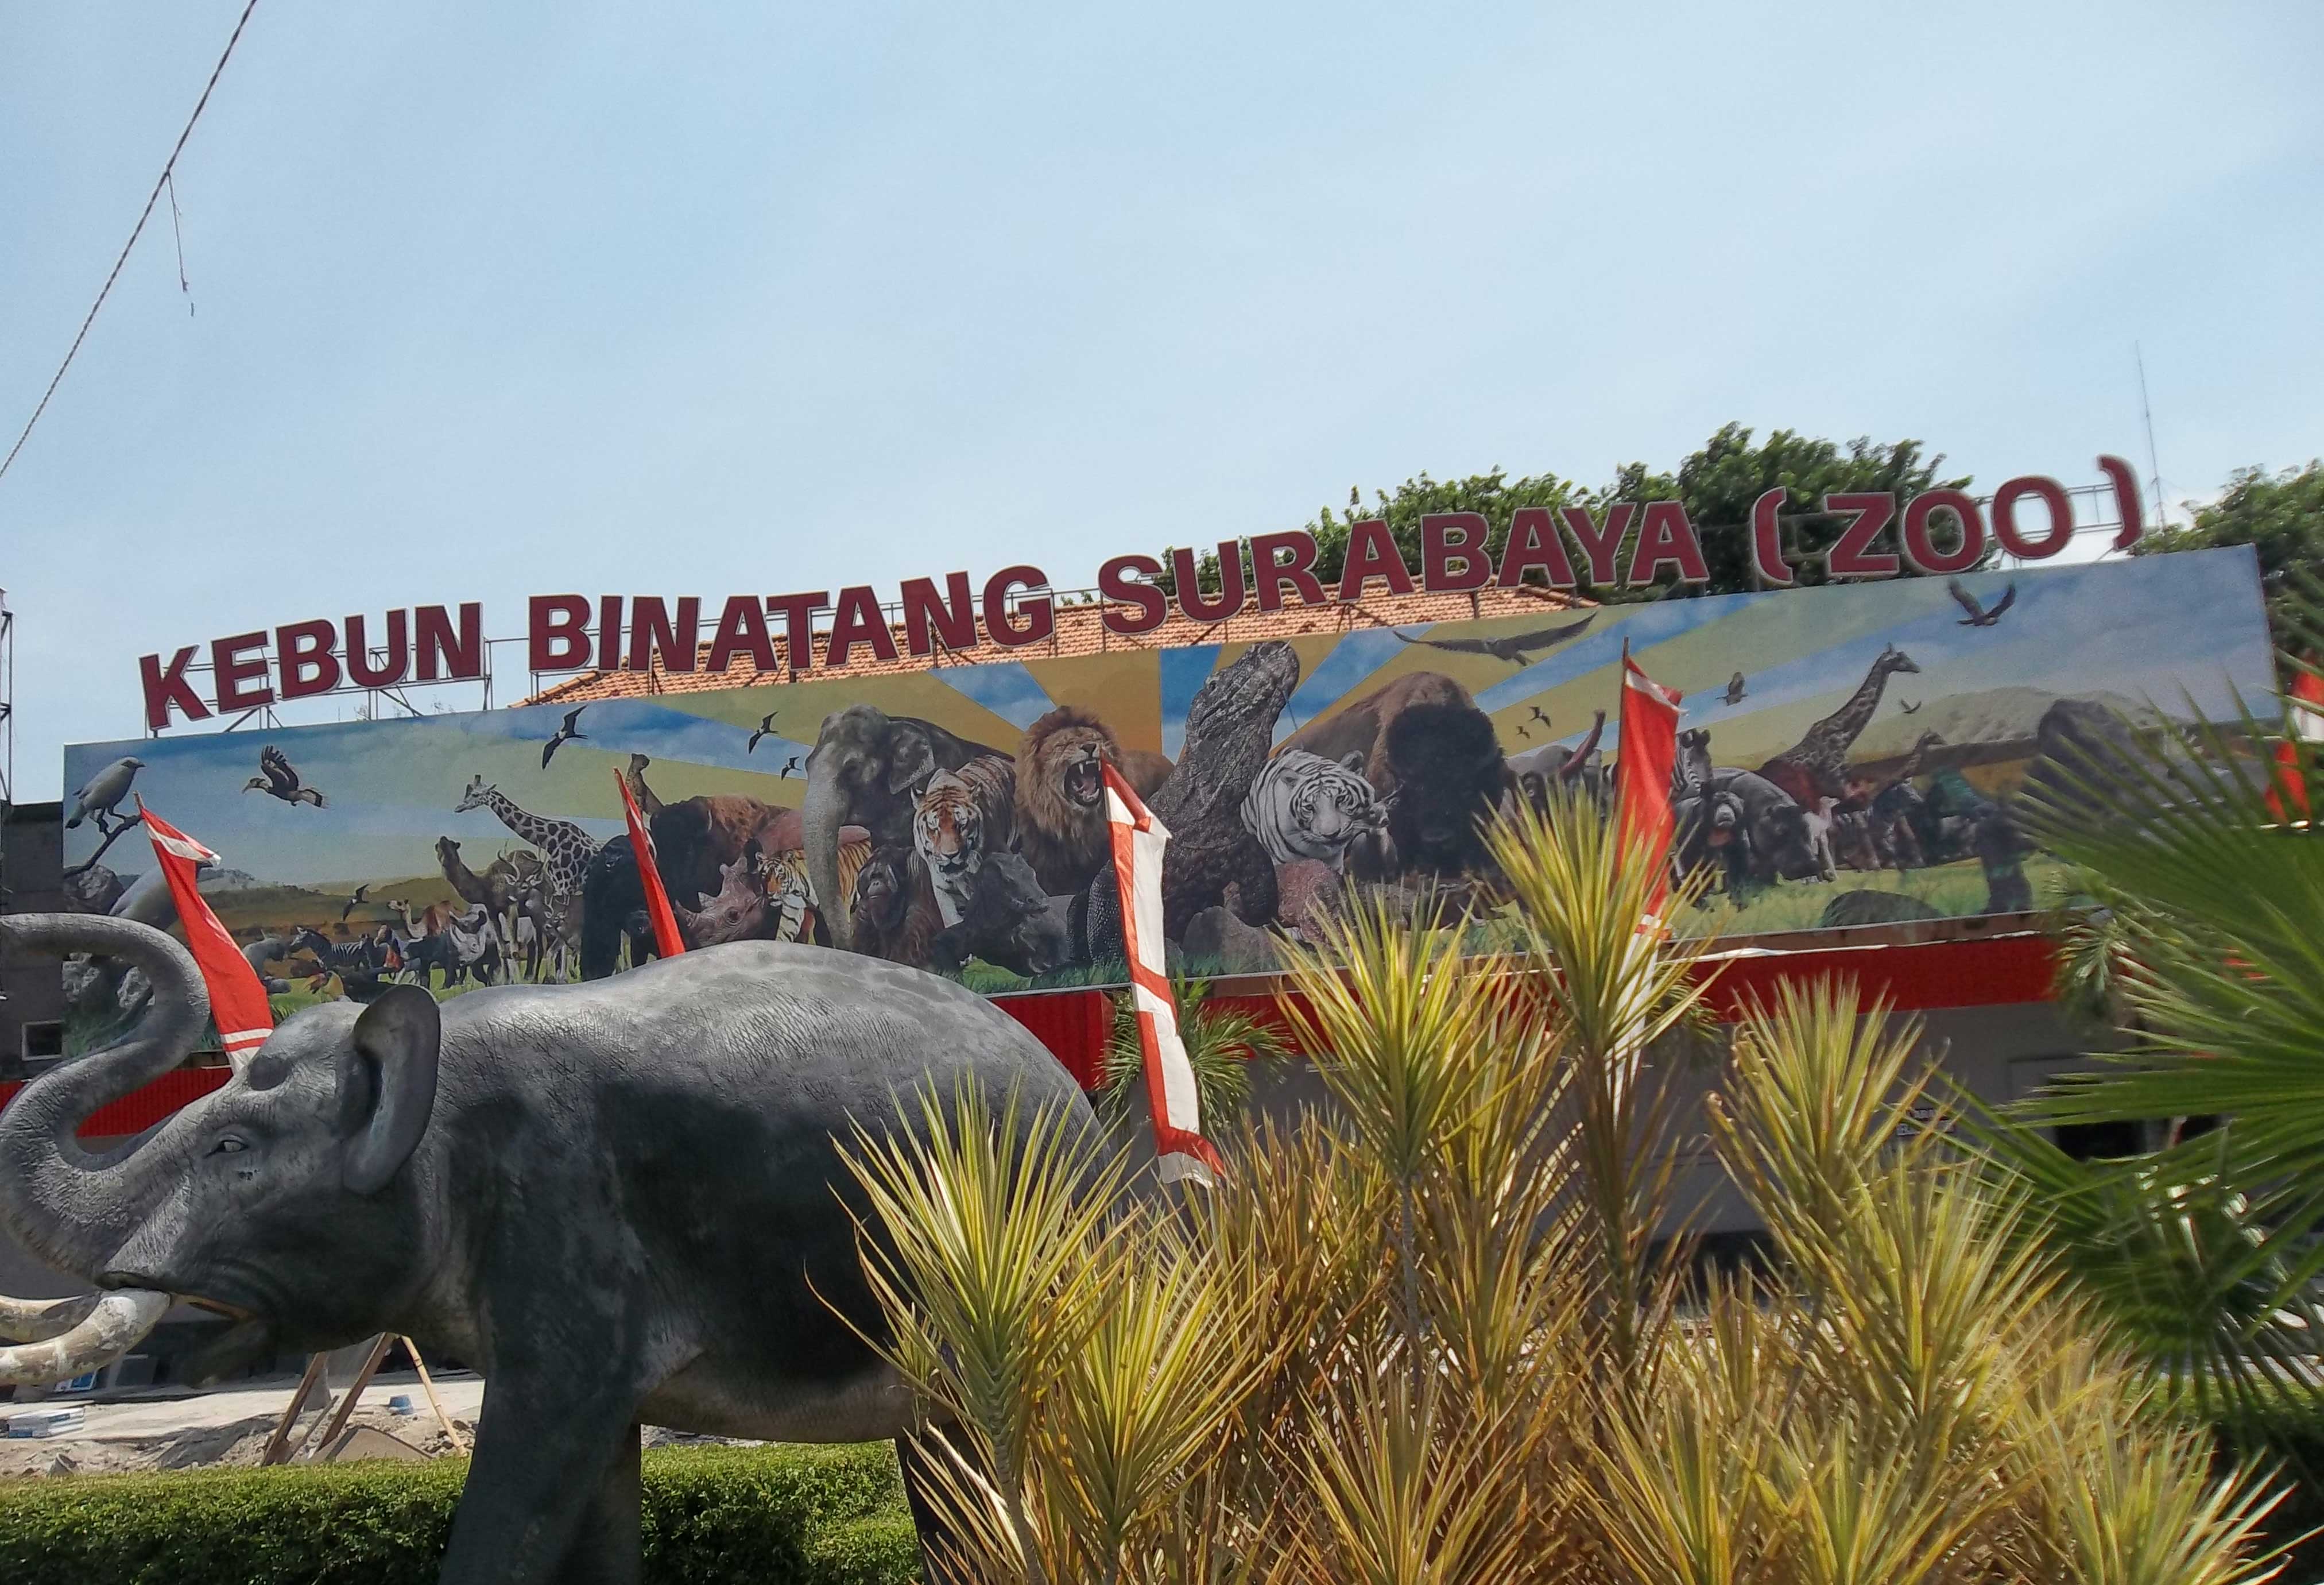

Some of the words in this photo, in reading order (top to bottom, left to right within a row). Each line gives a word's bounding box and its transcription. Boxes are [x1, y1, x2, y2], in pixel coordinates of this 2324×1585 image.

[139, 602, 485, 730] KEBUN
[529, 565, 1055, 673] BINATANG
[1098, 501, 1710, 636] SURABAYA
